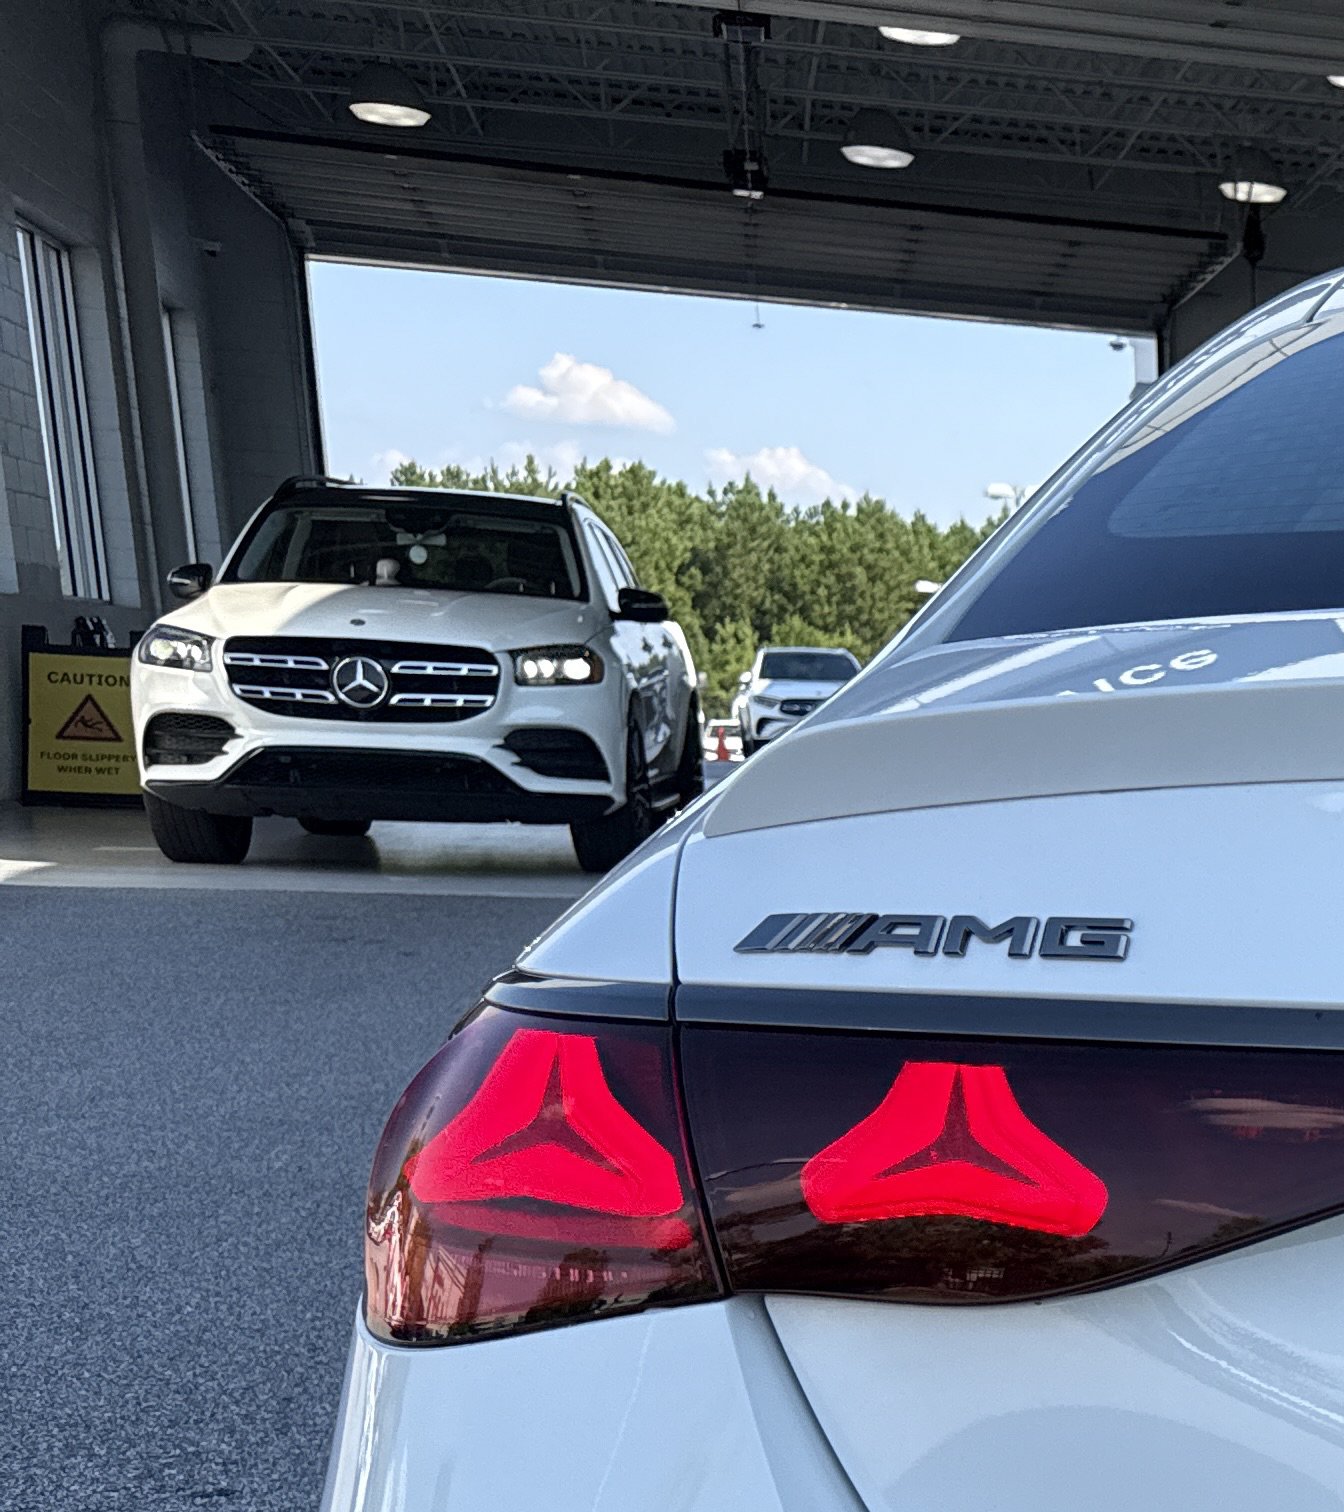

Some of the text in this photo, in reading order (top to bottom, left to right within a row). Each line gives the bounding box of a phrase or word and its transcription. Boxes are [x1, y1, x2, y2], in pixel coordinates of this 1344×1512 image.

[47, 671, 130, 688] CAUTION
[40, 751, 137, 763] FLOOR SLIPPERY
[95, 766, 120, 776] WET
[846, 914, 1133, 961] AMG
